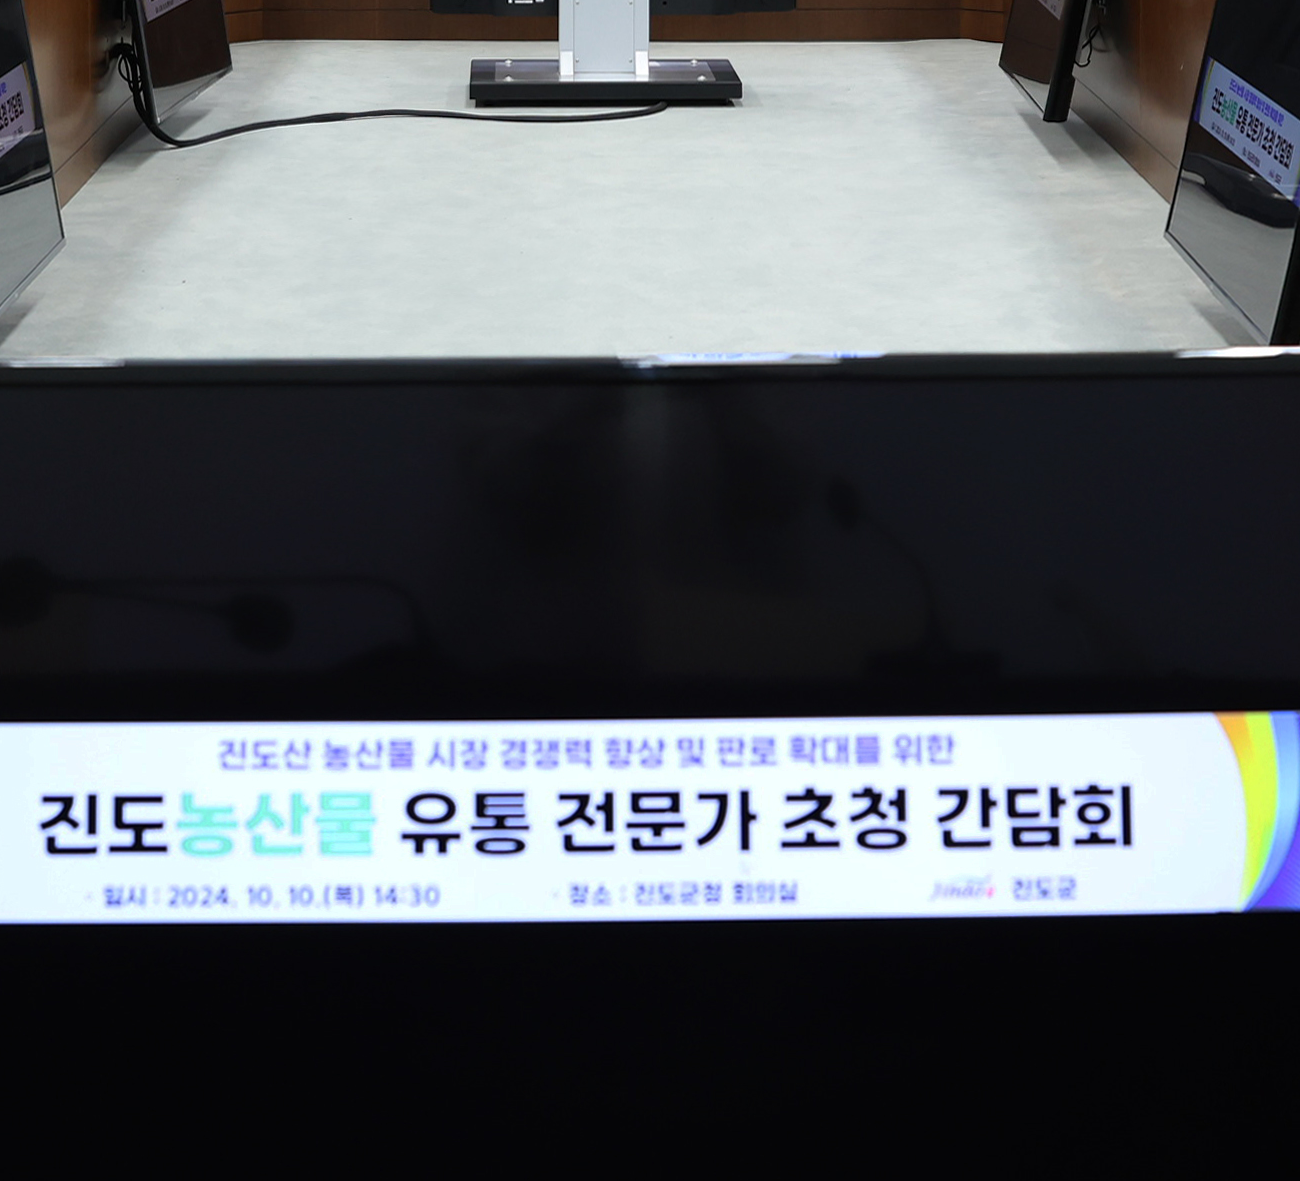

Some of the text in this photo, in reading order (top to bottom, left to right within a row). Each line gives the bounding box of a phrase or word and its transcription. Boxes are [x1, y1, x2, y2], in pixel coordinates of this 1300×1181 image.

[219, 739, 311, 770] 진도산
[324, 739, 415, 770] 농산물
[427, 738, 489, 769] 시장
[605, 737, 666, 768] 향상
[677, 737, 705, 768] 및
[718, 736, 778, 767] 판로
[892, 734, 955, 765] 위한
[40, 783, 1133, 856] 진도농산물 유통 전문가 초청 간담회
